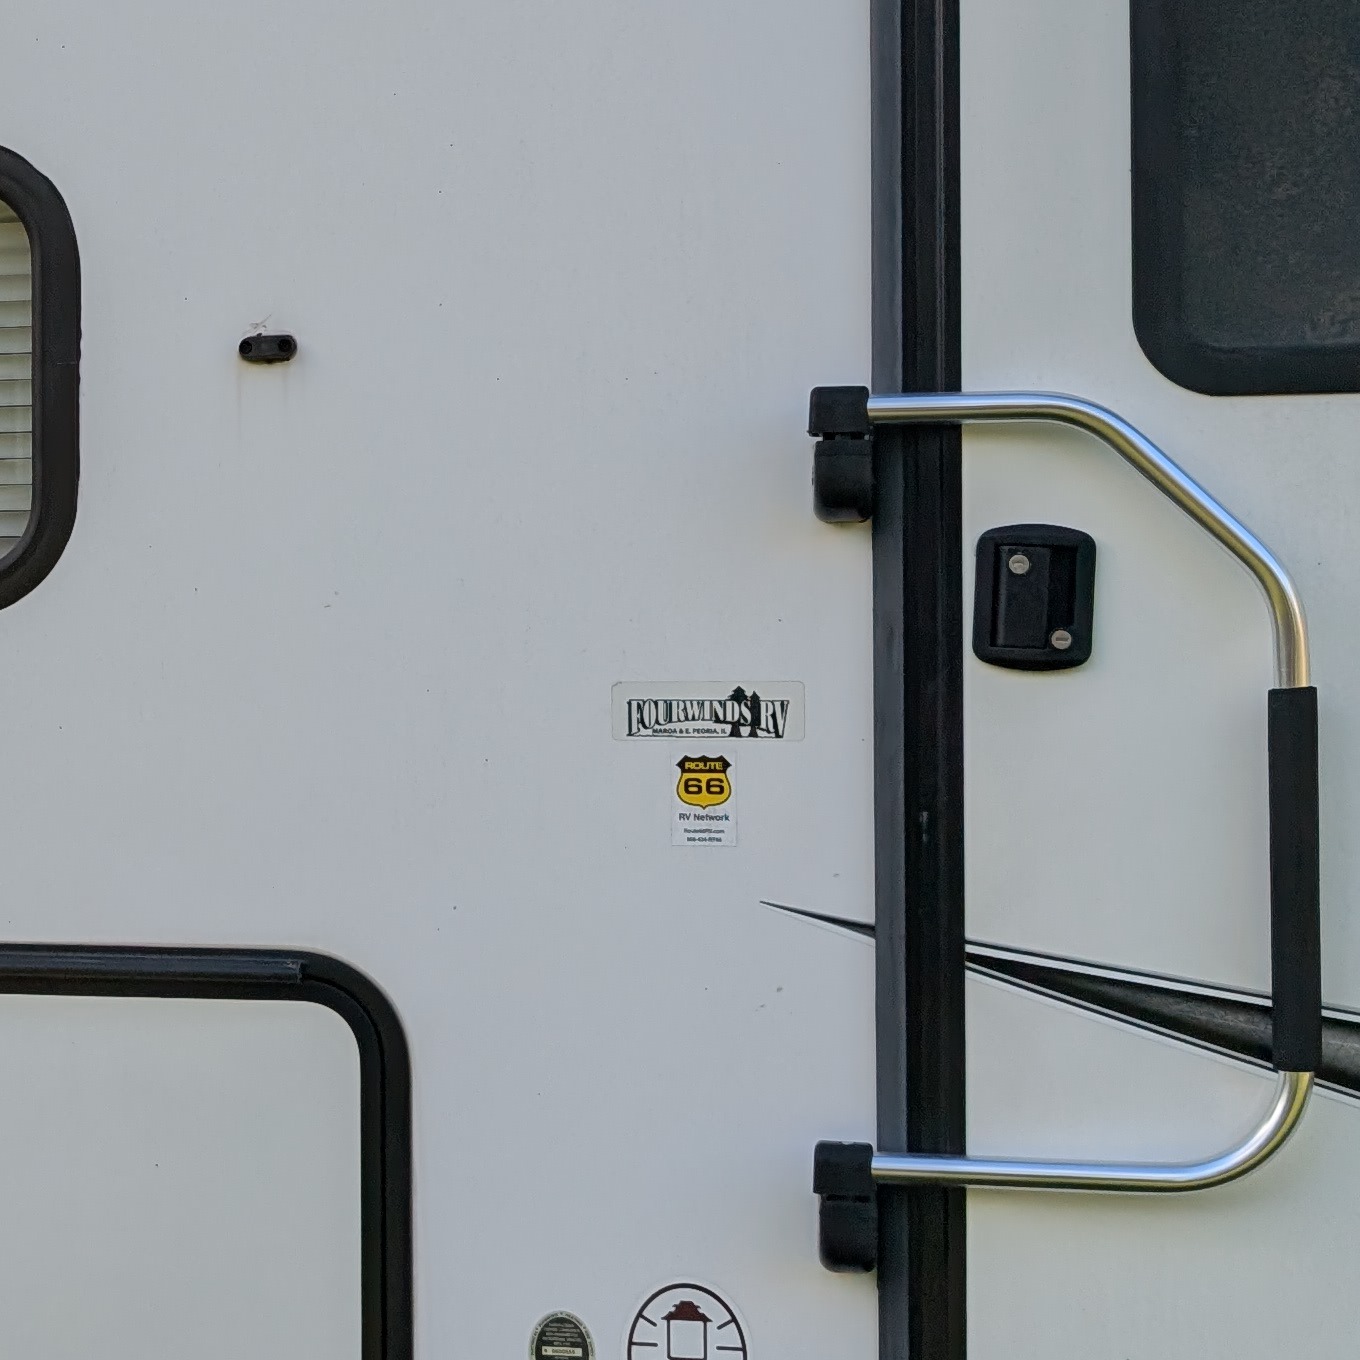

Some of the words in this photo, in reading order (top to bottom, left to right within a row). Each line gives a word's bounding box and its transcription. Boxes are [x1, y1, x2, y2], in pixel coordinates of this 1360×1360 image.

[626, 698, 752, 736] FOURWINDS
[759, 699, 790, 738] RV
[685, 761, 724, 770] ROUTE
[683, 777, 725, 795] 66
[678, 812, 691, 821] RV
[693, 812, 730, 822] Network
